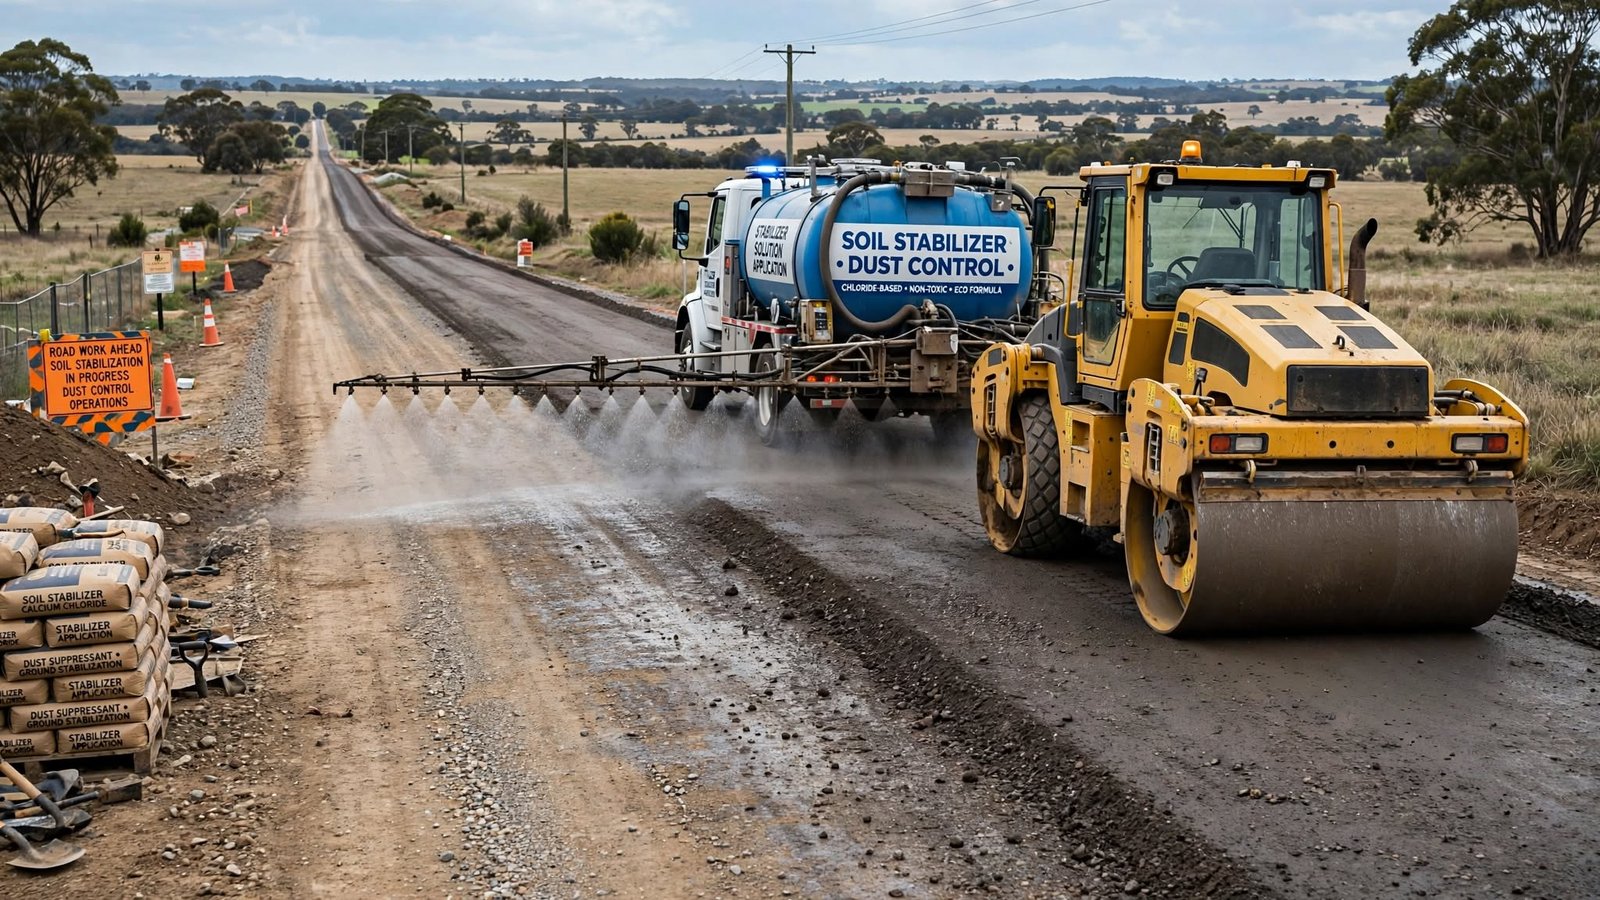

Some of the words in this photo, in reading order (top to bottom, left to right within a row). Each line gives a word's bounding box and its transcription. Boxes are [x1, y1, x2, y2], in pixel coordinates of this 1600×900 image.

[755, 225, 788, 240] STABILIZER
[842, 231, 888, 250] SOIL
[894, 232, 1006, 253] STABILIZER
[754, 242, 783, 258] SOLUTION
[753, 258, 788, 277] APPLICATION
[848, 256, 903, 274] DUST
[908, 257, 1004, 276] CONTROL
[841, 284, 902, 292] CHLORIDE-BASED
[910, 286, 948, 294] NON-TOXIC
[970, 286, 1002, 294] FORMULA
[50, 346, 75, 358] ROAD
[79, 345, 106, 356] WORK
[110, 344, 142, 354] AHEAD
[50, 360, 72, 371] SOIL
[76, 356, 144, 370] STABILIZATION
[66, 373, 75, 384] IN
[80, 370, 130, 382] PROGRESS
[63, 386, 86, 397] DUST
[90, 384, 134, 395] CONTROL
[70, 397, 128, 410] OPERATIONS
[22, 594, 44, 605] SOIL
[48, 590, 104, 602] STABILIZER
[22, 602, 60, 614] CALCIUM
[63, 600, 108, 610] CHLORIDE
[56, 621, 110, 634] STABILIZER
[58, 630, 113, 642] APPLICATION
[24, 658, 46, 668] DUST
[50, 652, 112, 666] SUPPRESSANT
[19, 666, 56, 677] GROUND
[58, 660, 122, 674] STABILIZATION
[68, 678, 122, 690] STABILIZER
[72, 687, 125, 699] APPLICATION
[31, 710, 54, 720] DUST
[56, 704, 120, 718] SUPPRESSANT
[26, 718, 64, 729] GROUND
[66, 712, 130, 726] STABILIZATION
[69, 730, 120, 742] STABILIZER
[72, 739, 124, 750] APPLICATION
